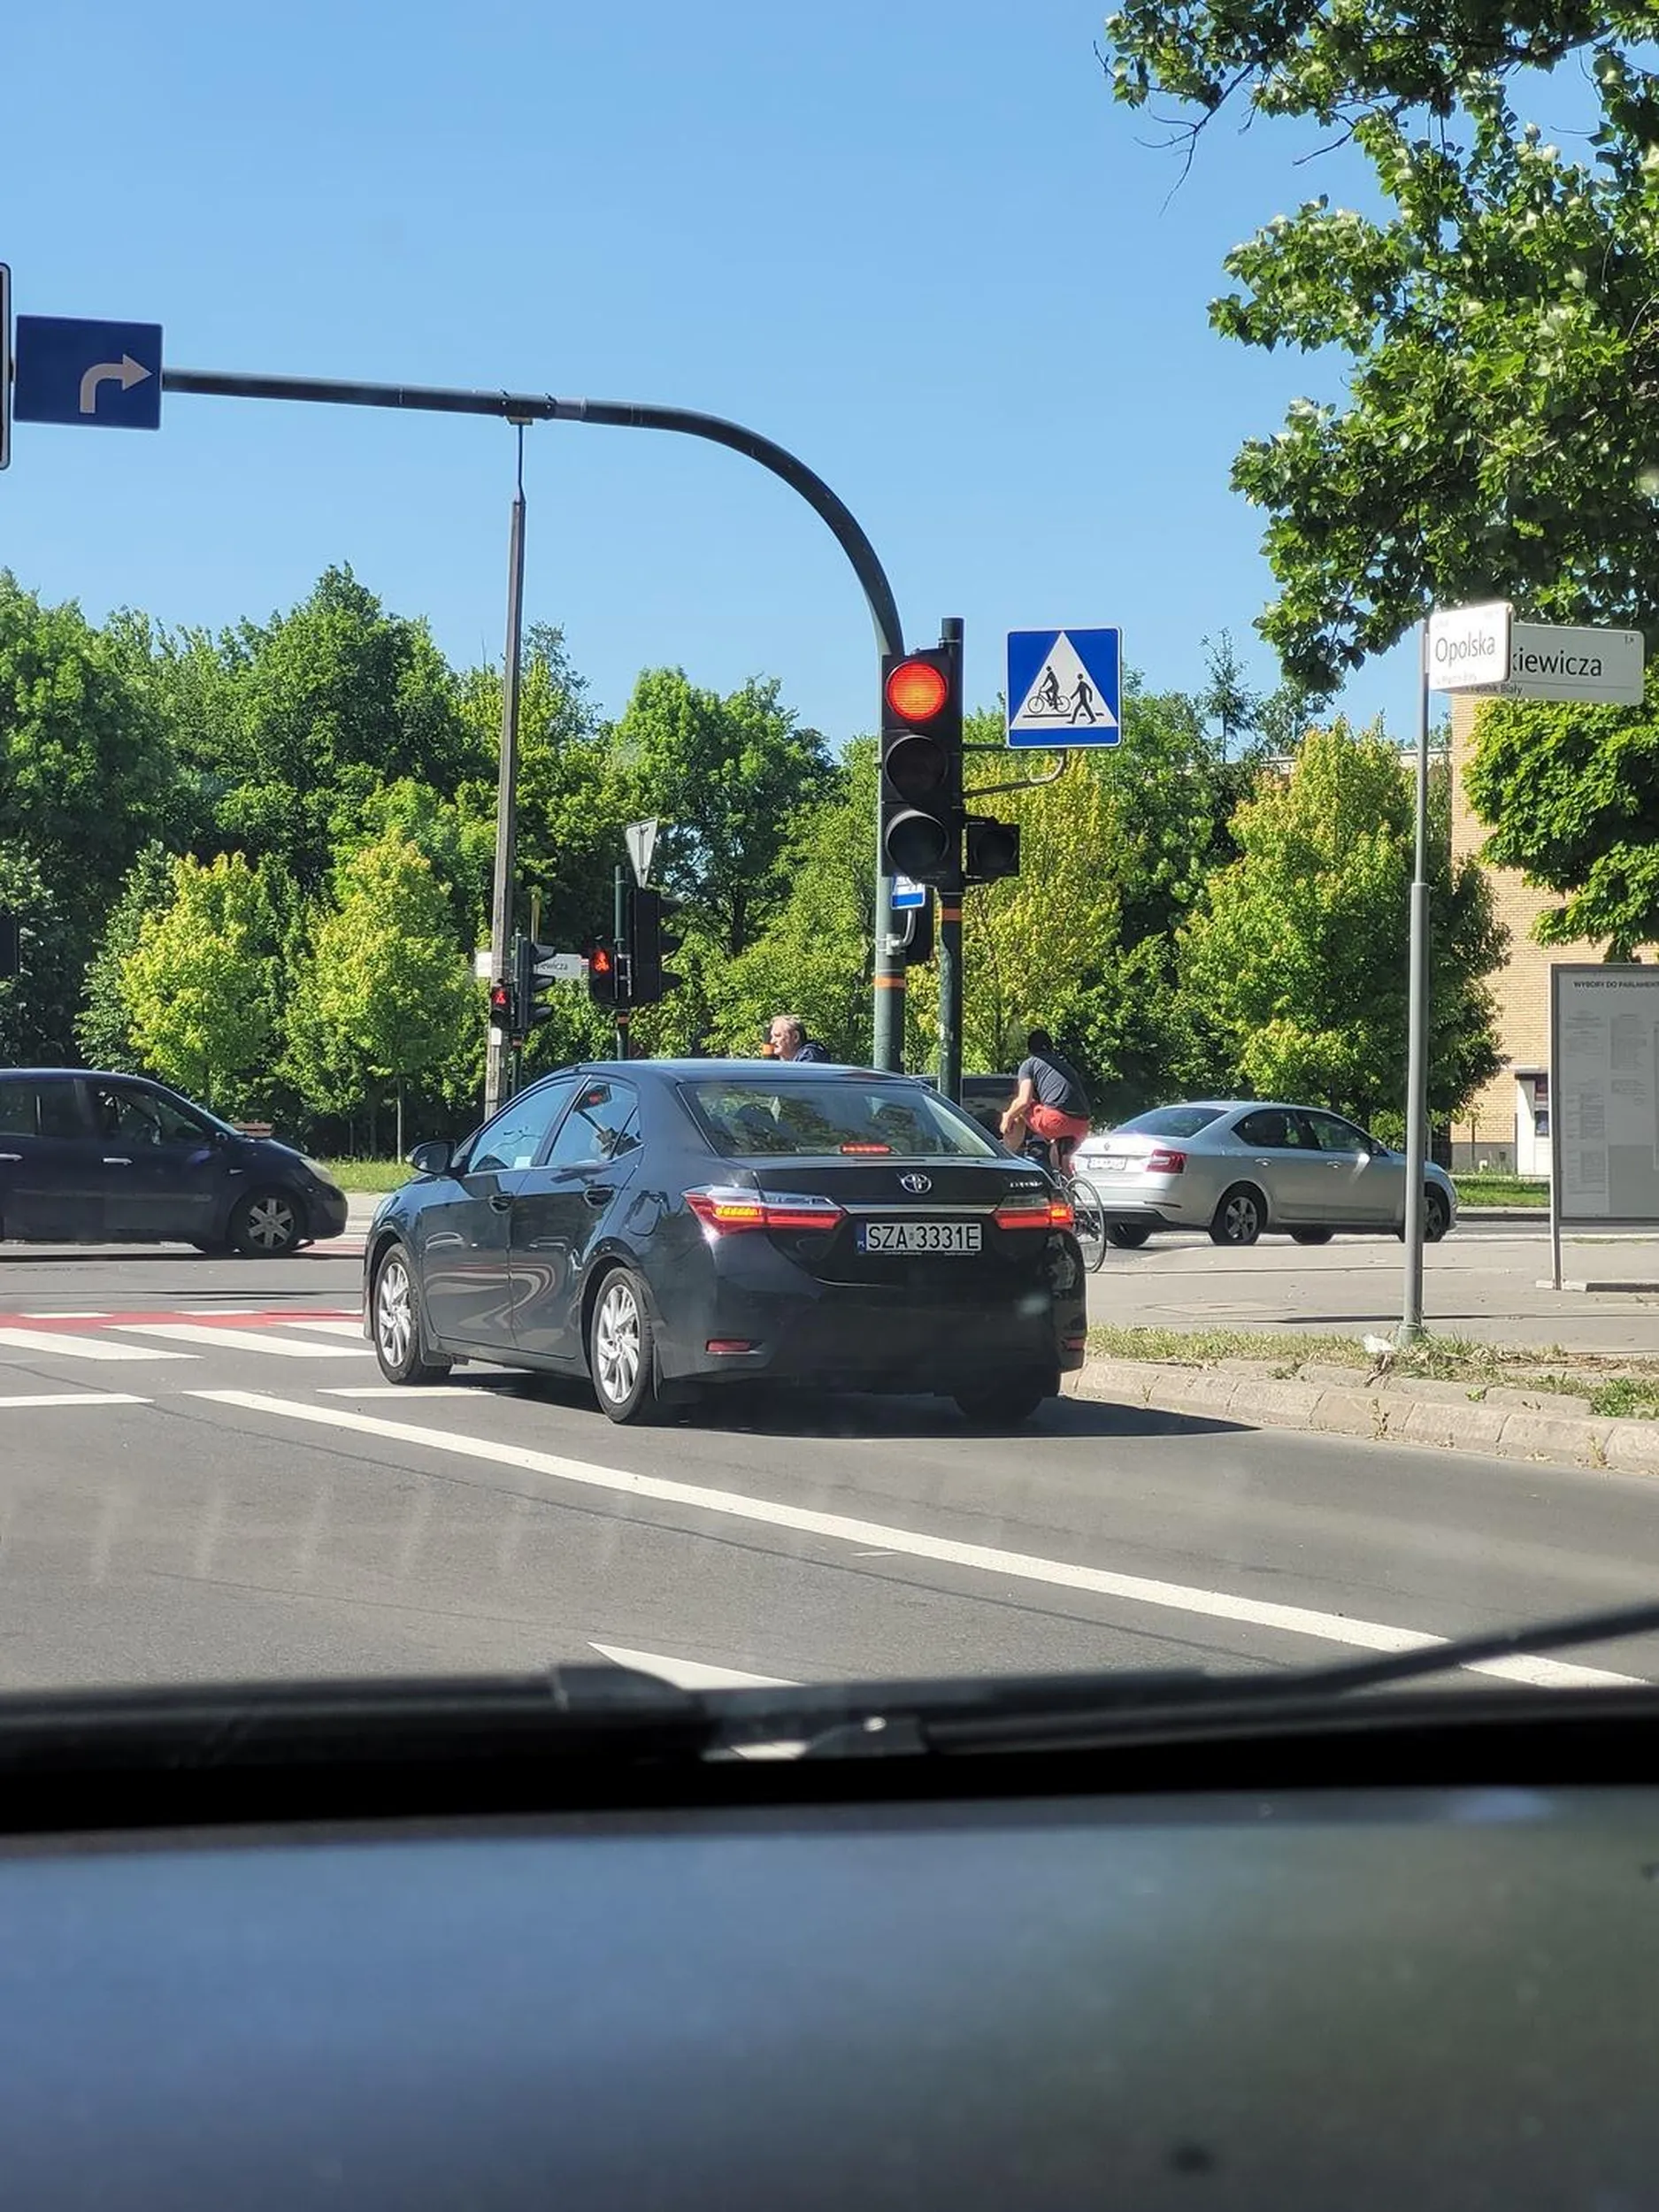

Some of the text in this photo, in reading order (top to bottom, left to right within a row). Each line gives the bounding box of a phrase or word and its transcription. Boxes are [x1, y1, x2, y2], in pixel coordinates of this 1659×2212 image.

[1435, 629, 1495, 668] Opolska
[868, 1225, 979, 1249] SZA 3331E
